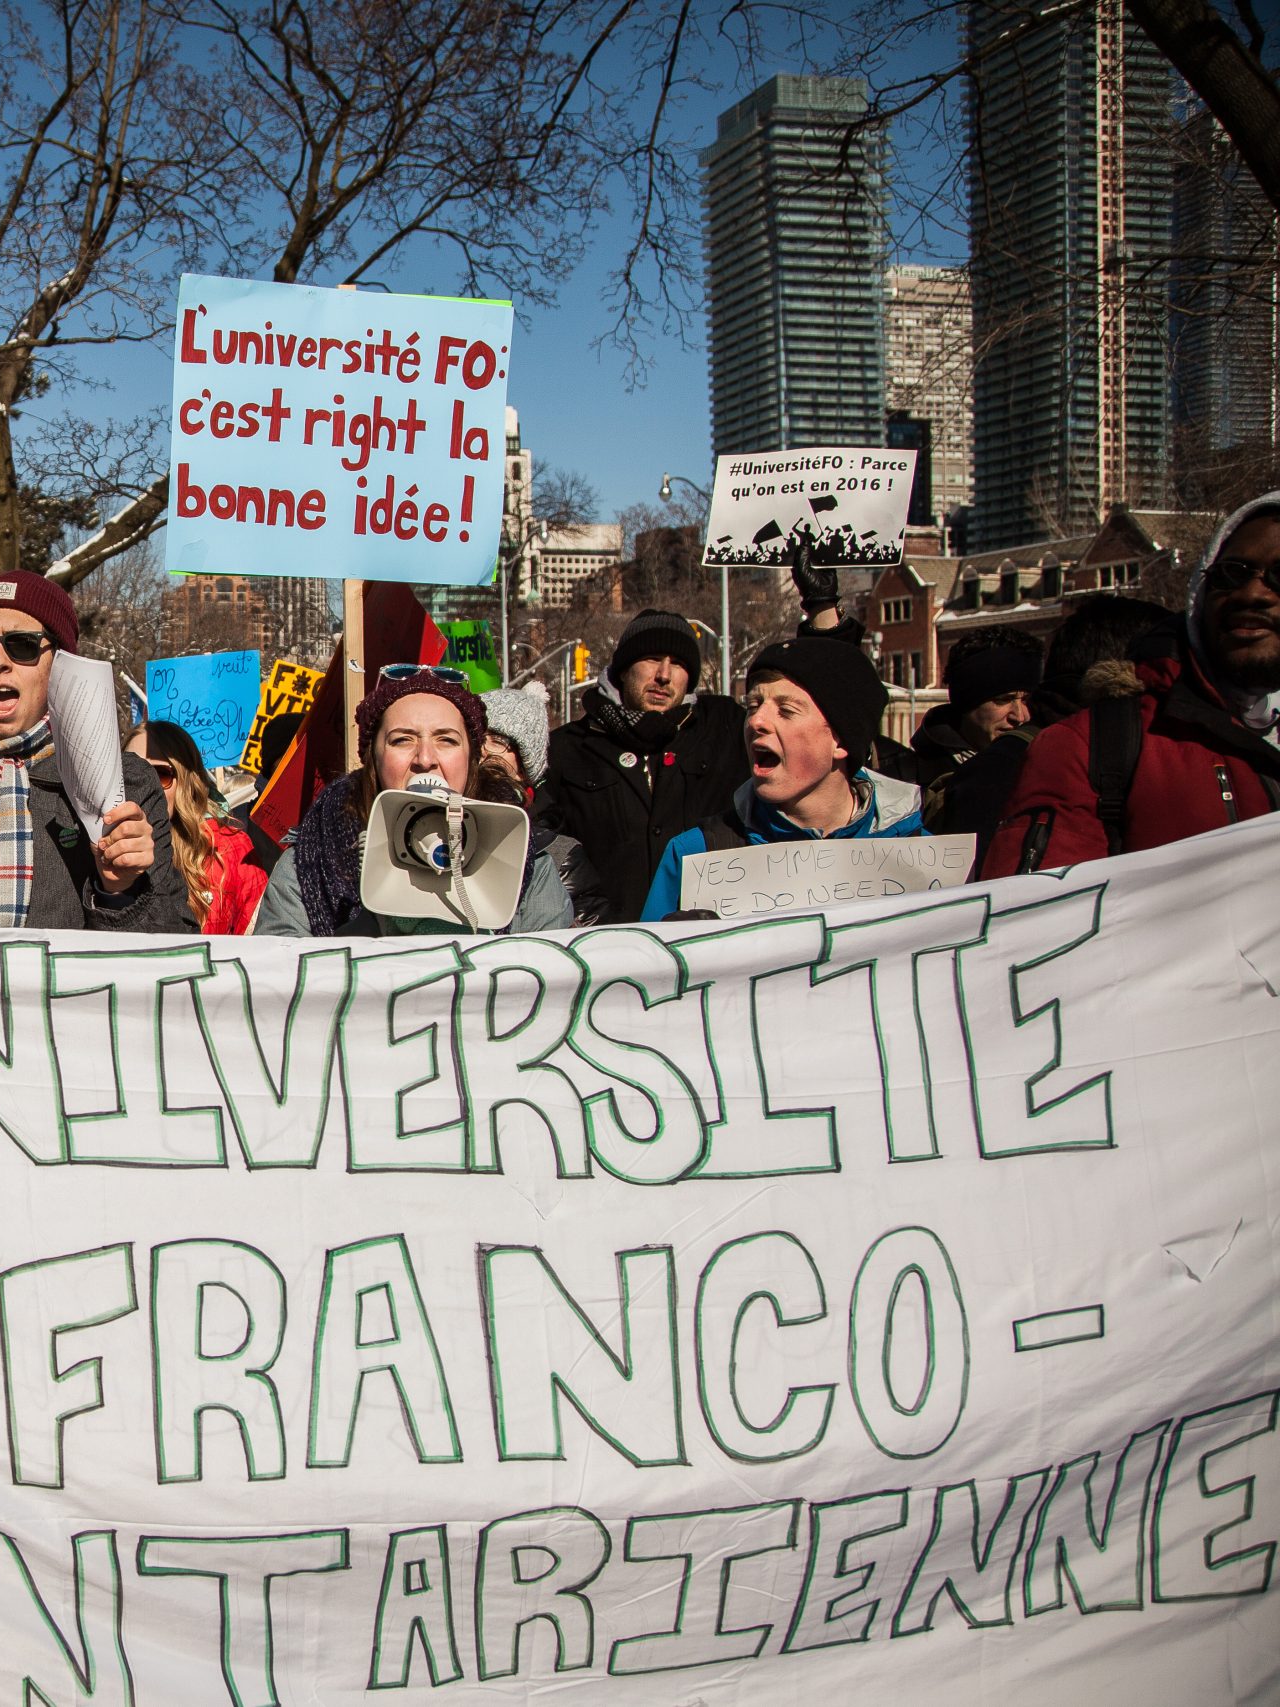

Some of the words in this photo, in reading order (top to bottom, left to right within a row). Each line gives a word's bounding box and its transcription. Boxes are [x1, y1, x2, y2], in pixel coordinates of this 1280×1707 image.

[181, 304, 420, 383] L'université
[434, 336, 507, 389] FO:
[180, 388, 291, 442] c'est
[303, 395, 426, 471] right
[449, 400, 489, 461] la
[729, 455, 843, 476] #UniversitéFO
[860, 456, 908, 472] Parce
[731, 483, 775, 501] qu'on
[781, 480, 805, 493] est
[810, 480, 830, 492] en
[836, 477, 880, 491] 2016
[177, 463, 327, 530] bonne
[691, 856, 746, 894] YES
[767, 844, 837, 878] MME
[851, 840, 970, 871] WYNNE
[751, 891, 795, 913] DO
[807, 878, 905, 906] NEED
